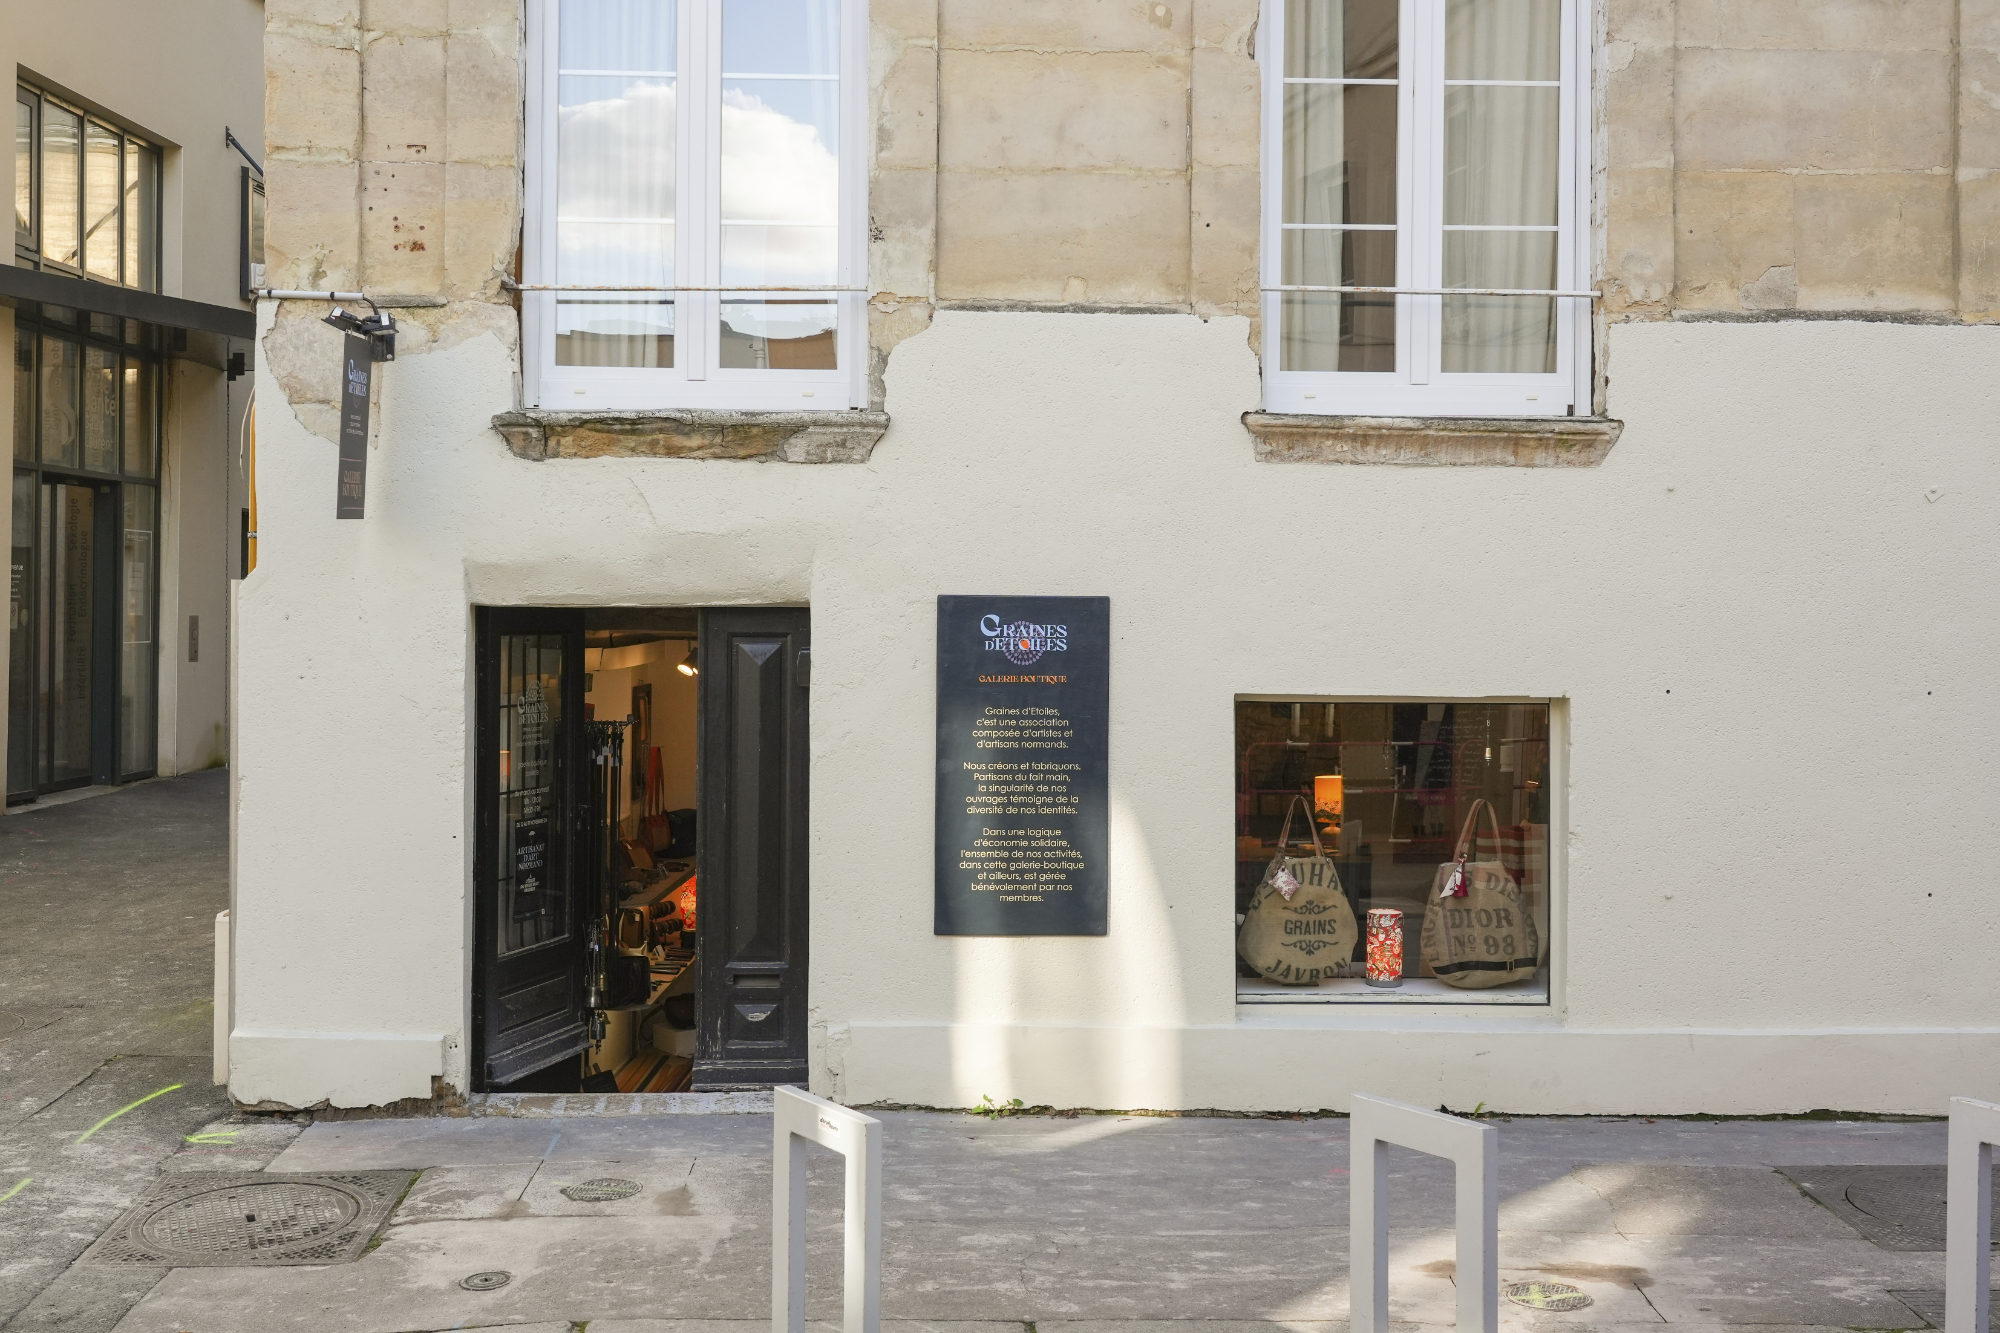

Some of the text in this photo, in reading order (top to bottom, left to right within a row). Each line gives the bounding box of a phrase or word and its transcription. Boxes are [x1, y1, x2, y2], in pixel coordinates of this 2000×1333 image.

[68, 498, 80, 551] Sexologie
[78, 530, 90, 618] Endocrinologue
[980, 614, 1068, 638] GRAINES
[978, 675, 1068, 685] GALERIE BOUTIQUE
[517, 696, 549, 714] GRAINES
[984, 706, 1061, 717] Graines d'Etoiles,
[975, 717, 1069, 727] c'est une association
[971, 728, 1074, 739] composée d'artistes et
[976, 739, 1069, 749] d'artisans normands.
[963, 761, 1082, 772] Nous créons et fabriquons.
[973, 772, 1071, 783] Partisans du fait main,
[977, 783, 1067, 794] la singularité de nos
[965, 794, 1079, 805] ouvrages témoigne de la
[966, 805, 1078, 815] diversité de nos identités.
[982, 827, 1006, 836] Dans
[1027, 827, 1062, 838] logique
[973, 838, 1071, 848] d'économie solidaire,
[516, 843, 545, 855] ARTISANAT
[960, 849, 1083, 860] l'ensemble de nos activités,
[958, 860, 1085, 871] dans cette galerie-boutique
[977, 871, 1067, 882] et ailleurs, est gérée
[970, 881, 1038, 891] bénévolement
[1038, 884, 1056, 893] par
[999, 893, 1045, 902] membres.
[1447, 907, 1514, 929] DIOR
[1284, 918, 1337, 935] GRAINS
[1484, 934, 1516, 956] 98
[1264, 957, 1349, 982] JAVRON
